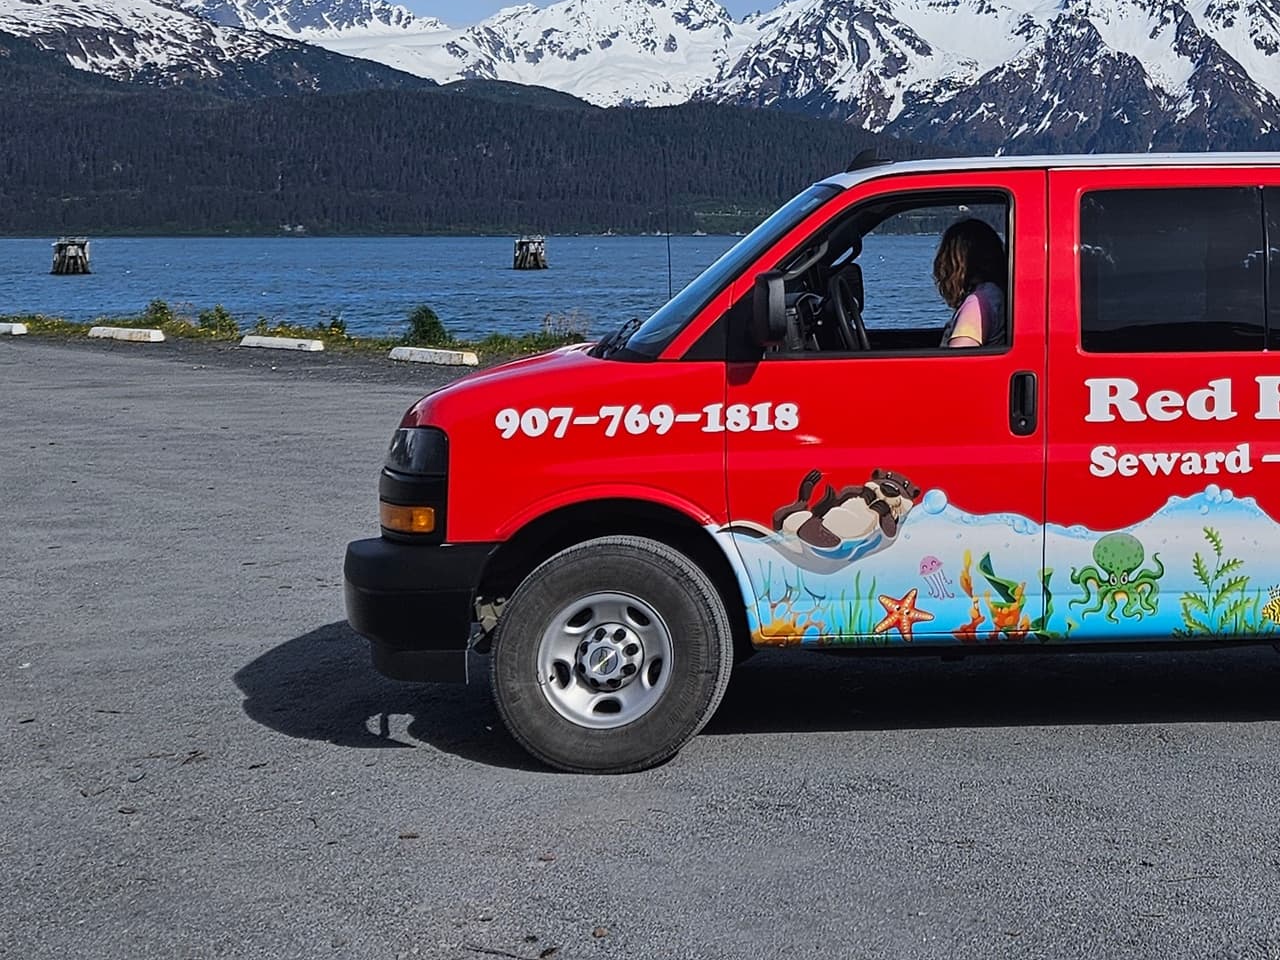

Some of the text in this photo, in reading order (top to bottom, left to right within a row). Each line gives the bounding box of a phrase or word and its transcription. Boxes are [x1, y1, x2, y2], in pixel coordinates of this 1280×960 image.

[1084, 377, 1238, 422] Red
[495, 402, 799, 439] 907-769-1818
[1089, 442, 1253, 477] Seward
